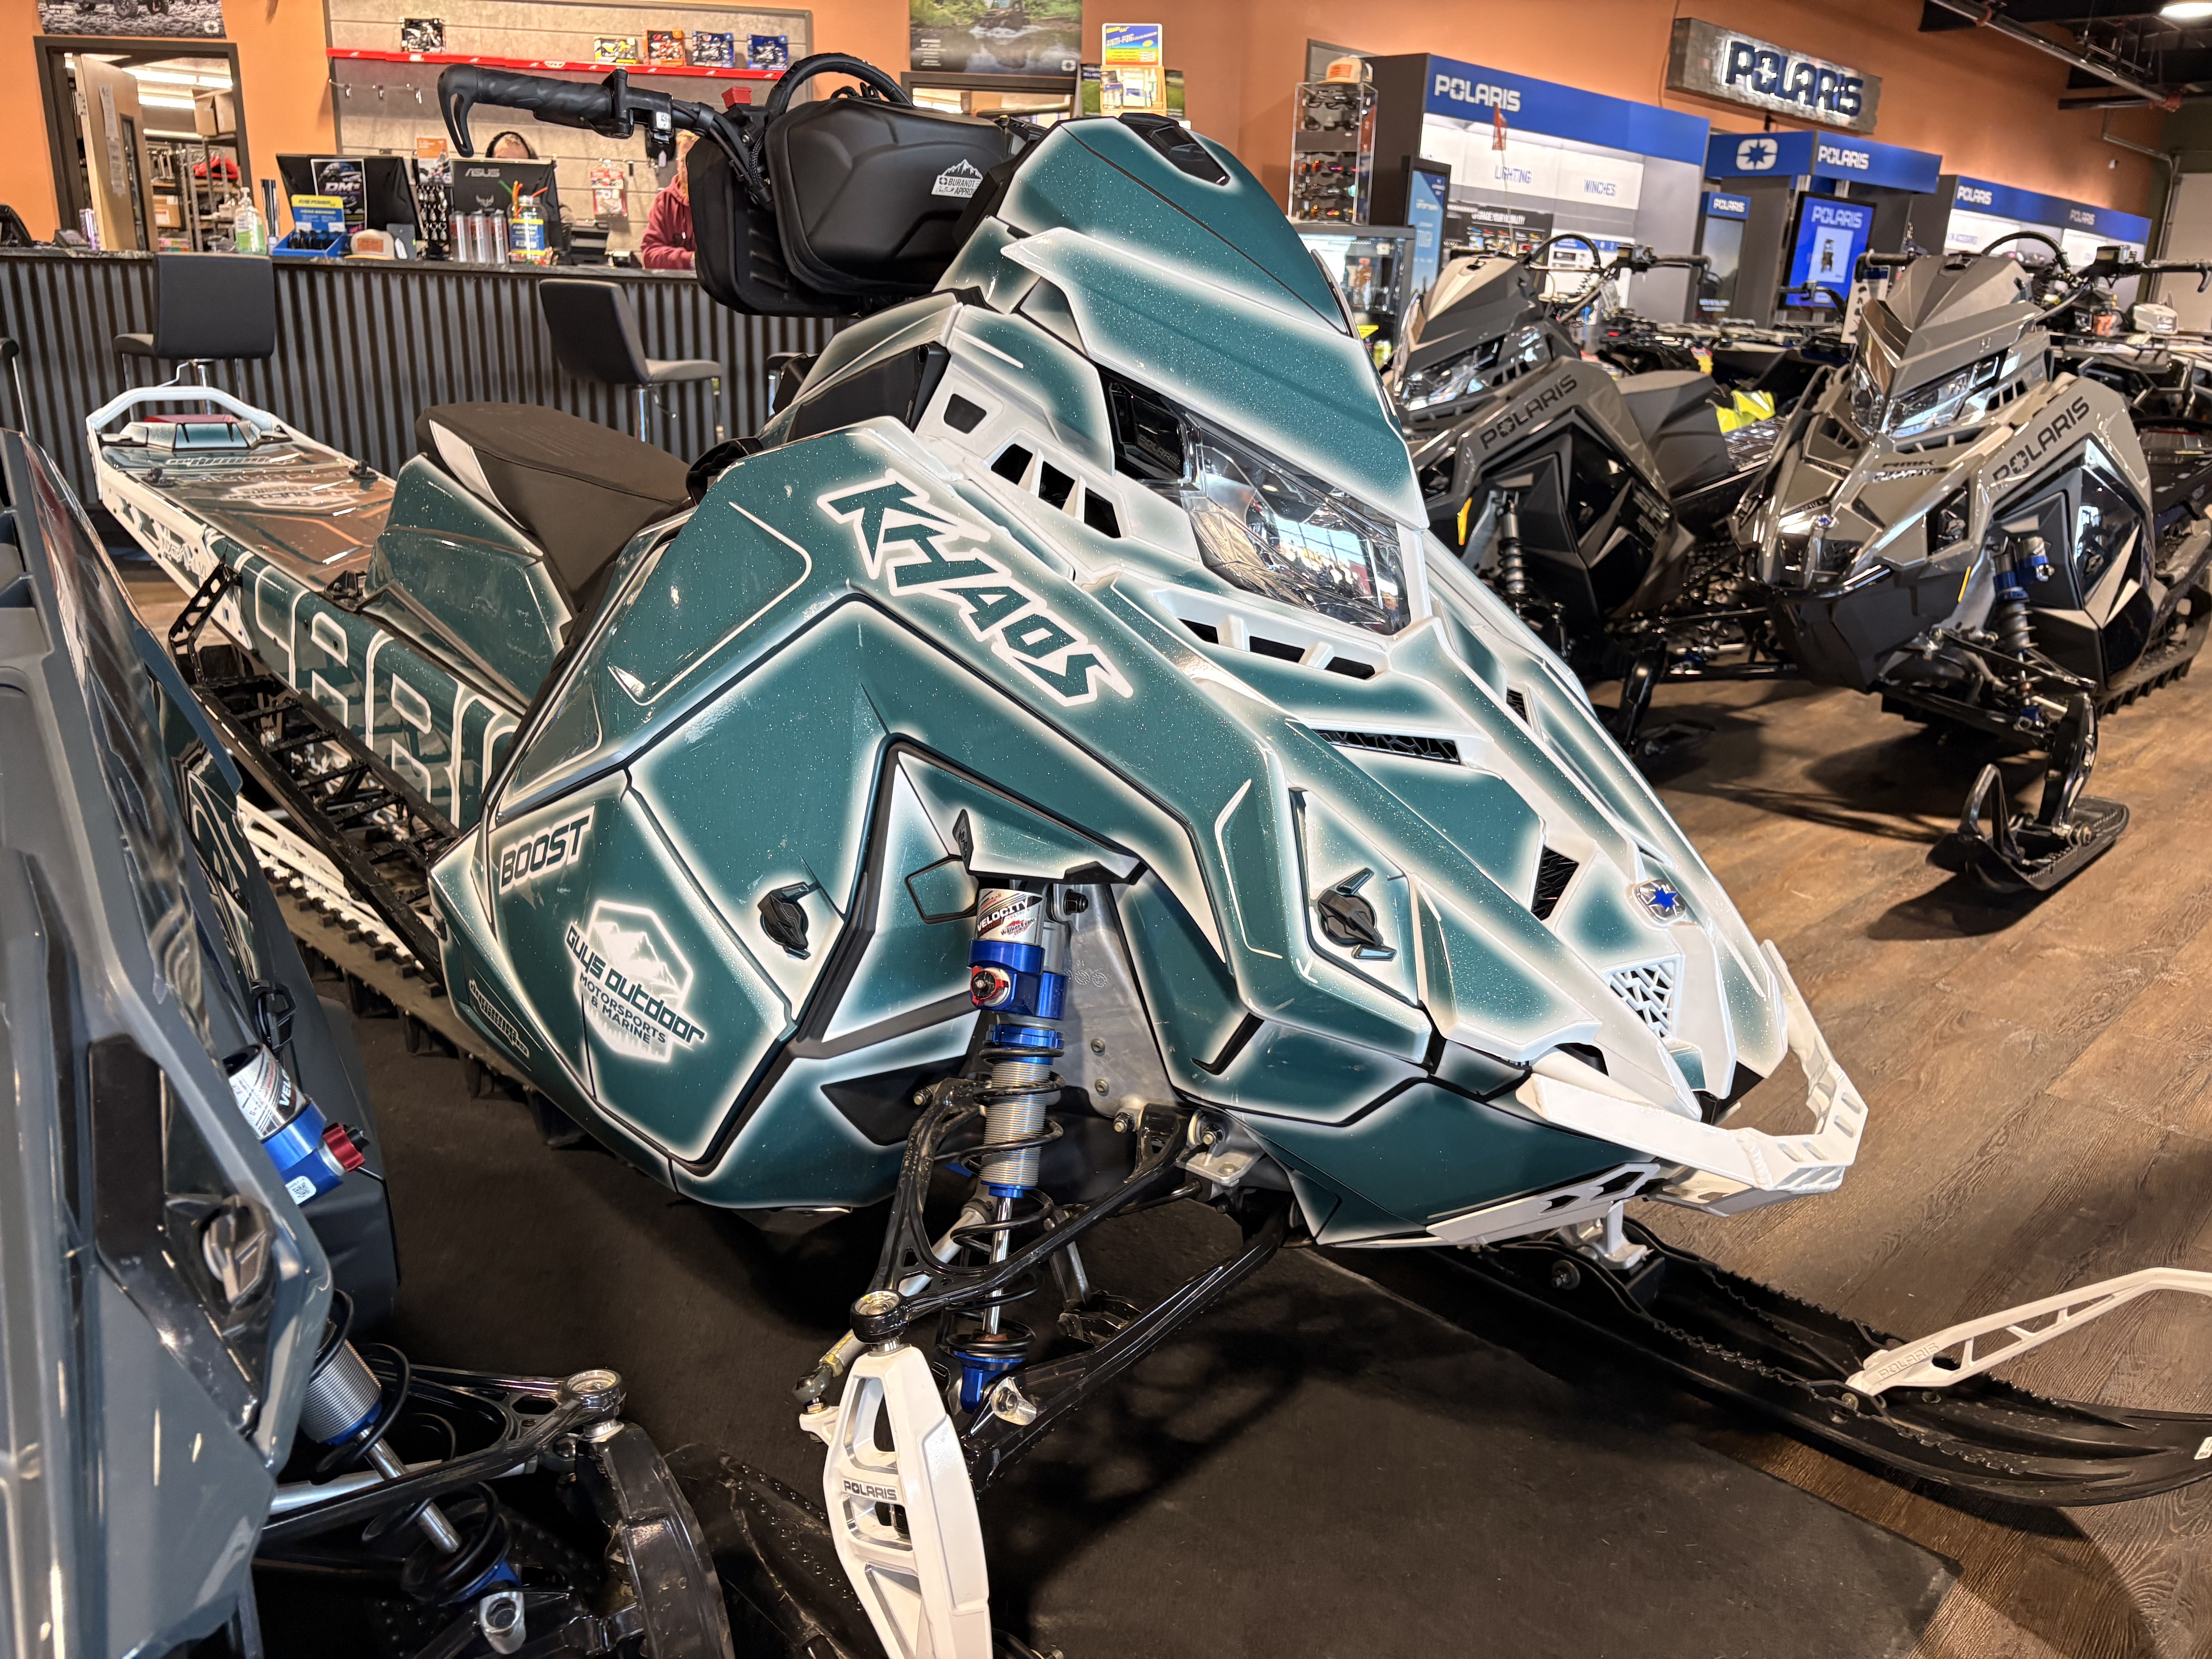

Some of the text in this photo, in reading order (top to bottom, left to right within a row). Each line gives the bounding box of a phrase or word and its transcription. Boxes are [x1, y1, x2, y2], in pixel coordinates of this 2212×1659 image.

[1724, 40, 1863, 117] POLARIS
[1434, 74, 1520, 113] POLARIS
[465, 167, 501, 178] ASUS
[1818, 146, 1869, 170] POLARIS
[1494, 165, 1532, 184] LIGHTING
[1584, 179, 1617, 197] WINCHES
[954, 187, 975, 196] APPRO
[1714, 198, 1745, 213] POLARIS
[1957, 185, 1993, 205] POLARIS
[1811, 206, 1863, 229] POLARIS
[2069, 209, 2095, 225] POLARIS
[1479, 374, 1577, 450] POLARIS
[1992, 396, 2090, 489] POLARIS
[821, 473, 1125, 704] KHAOS
[500, 812, 592, 890] BOOST
[977, 898, 1028, 932] VELOCITY
[579, 972, 666, 1043] MOTORSPORTS
[591, 995, 651, 1044] & MARINE
[1877, 1343, 1939, 1378] POLARIS
[843, 1480, 898, 1502] POLARIS
